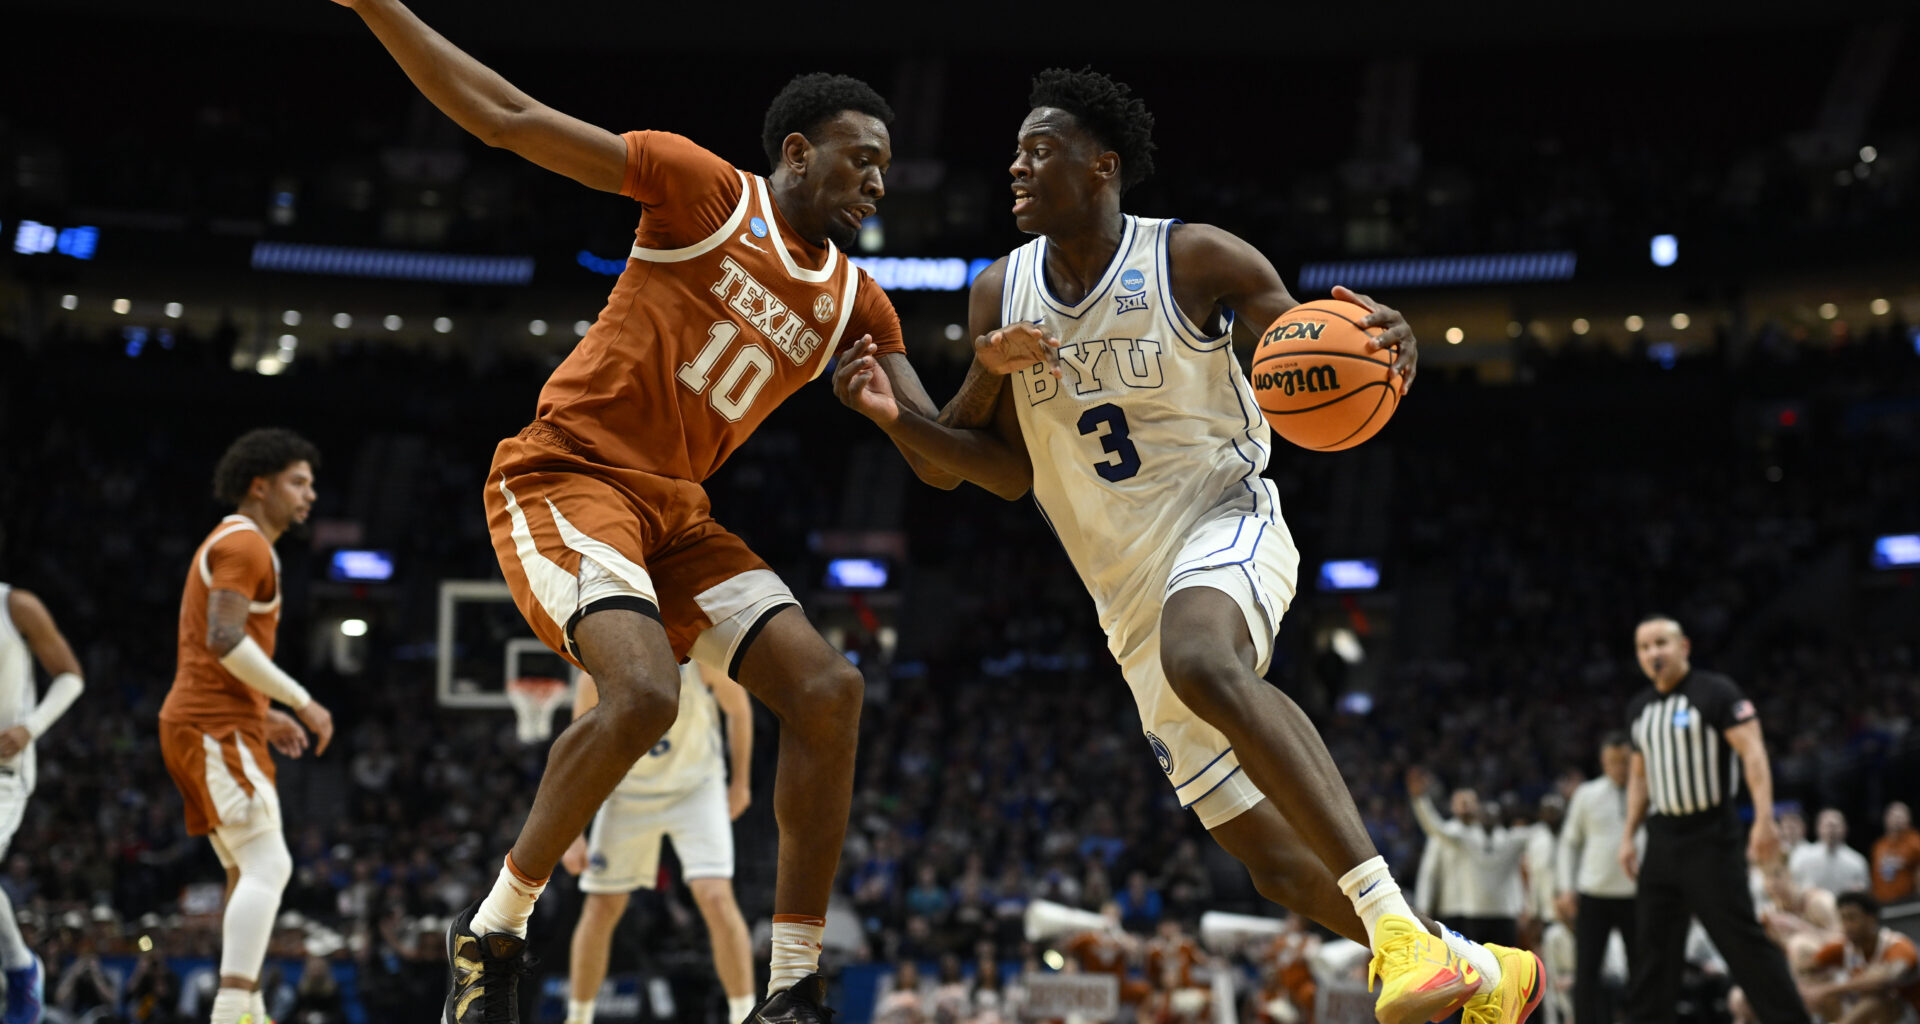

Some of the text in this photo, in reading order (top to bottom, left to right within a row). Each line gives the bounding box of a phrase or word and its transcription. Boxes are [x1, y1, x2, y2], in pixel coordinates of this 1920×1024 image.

[710, 255, 823, 366] TEXAS
[1262, 322, 1326, 348] NCAA
[675, 320, 774, 423] 10
[1019, 338, 1164, 407] BYU
[1254, 364, 1340, 396] Wilson
[1077, 402, 1142, 483] 3
